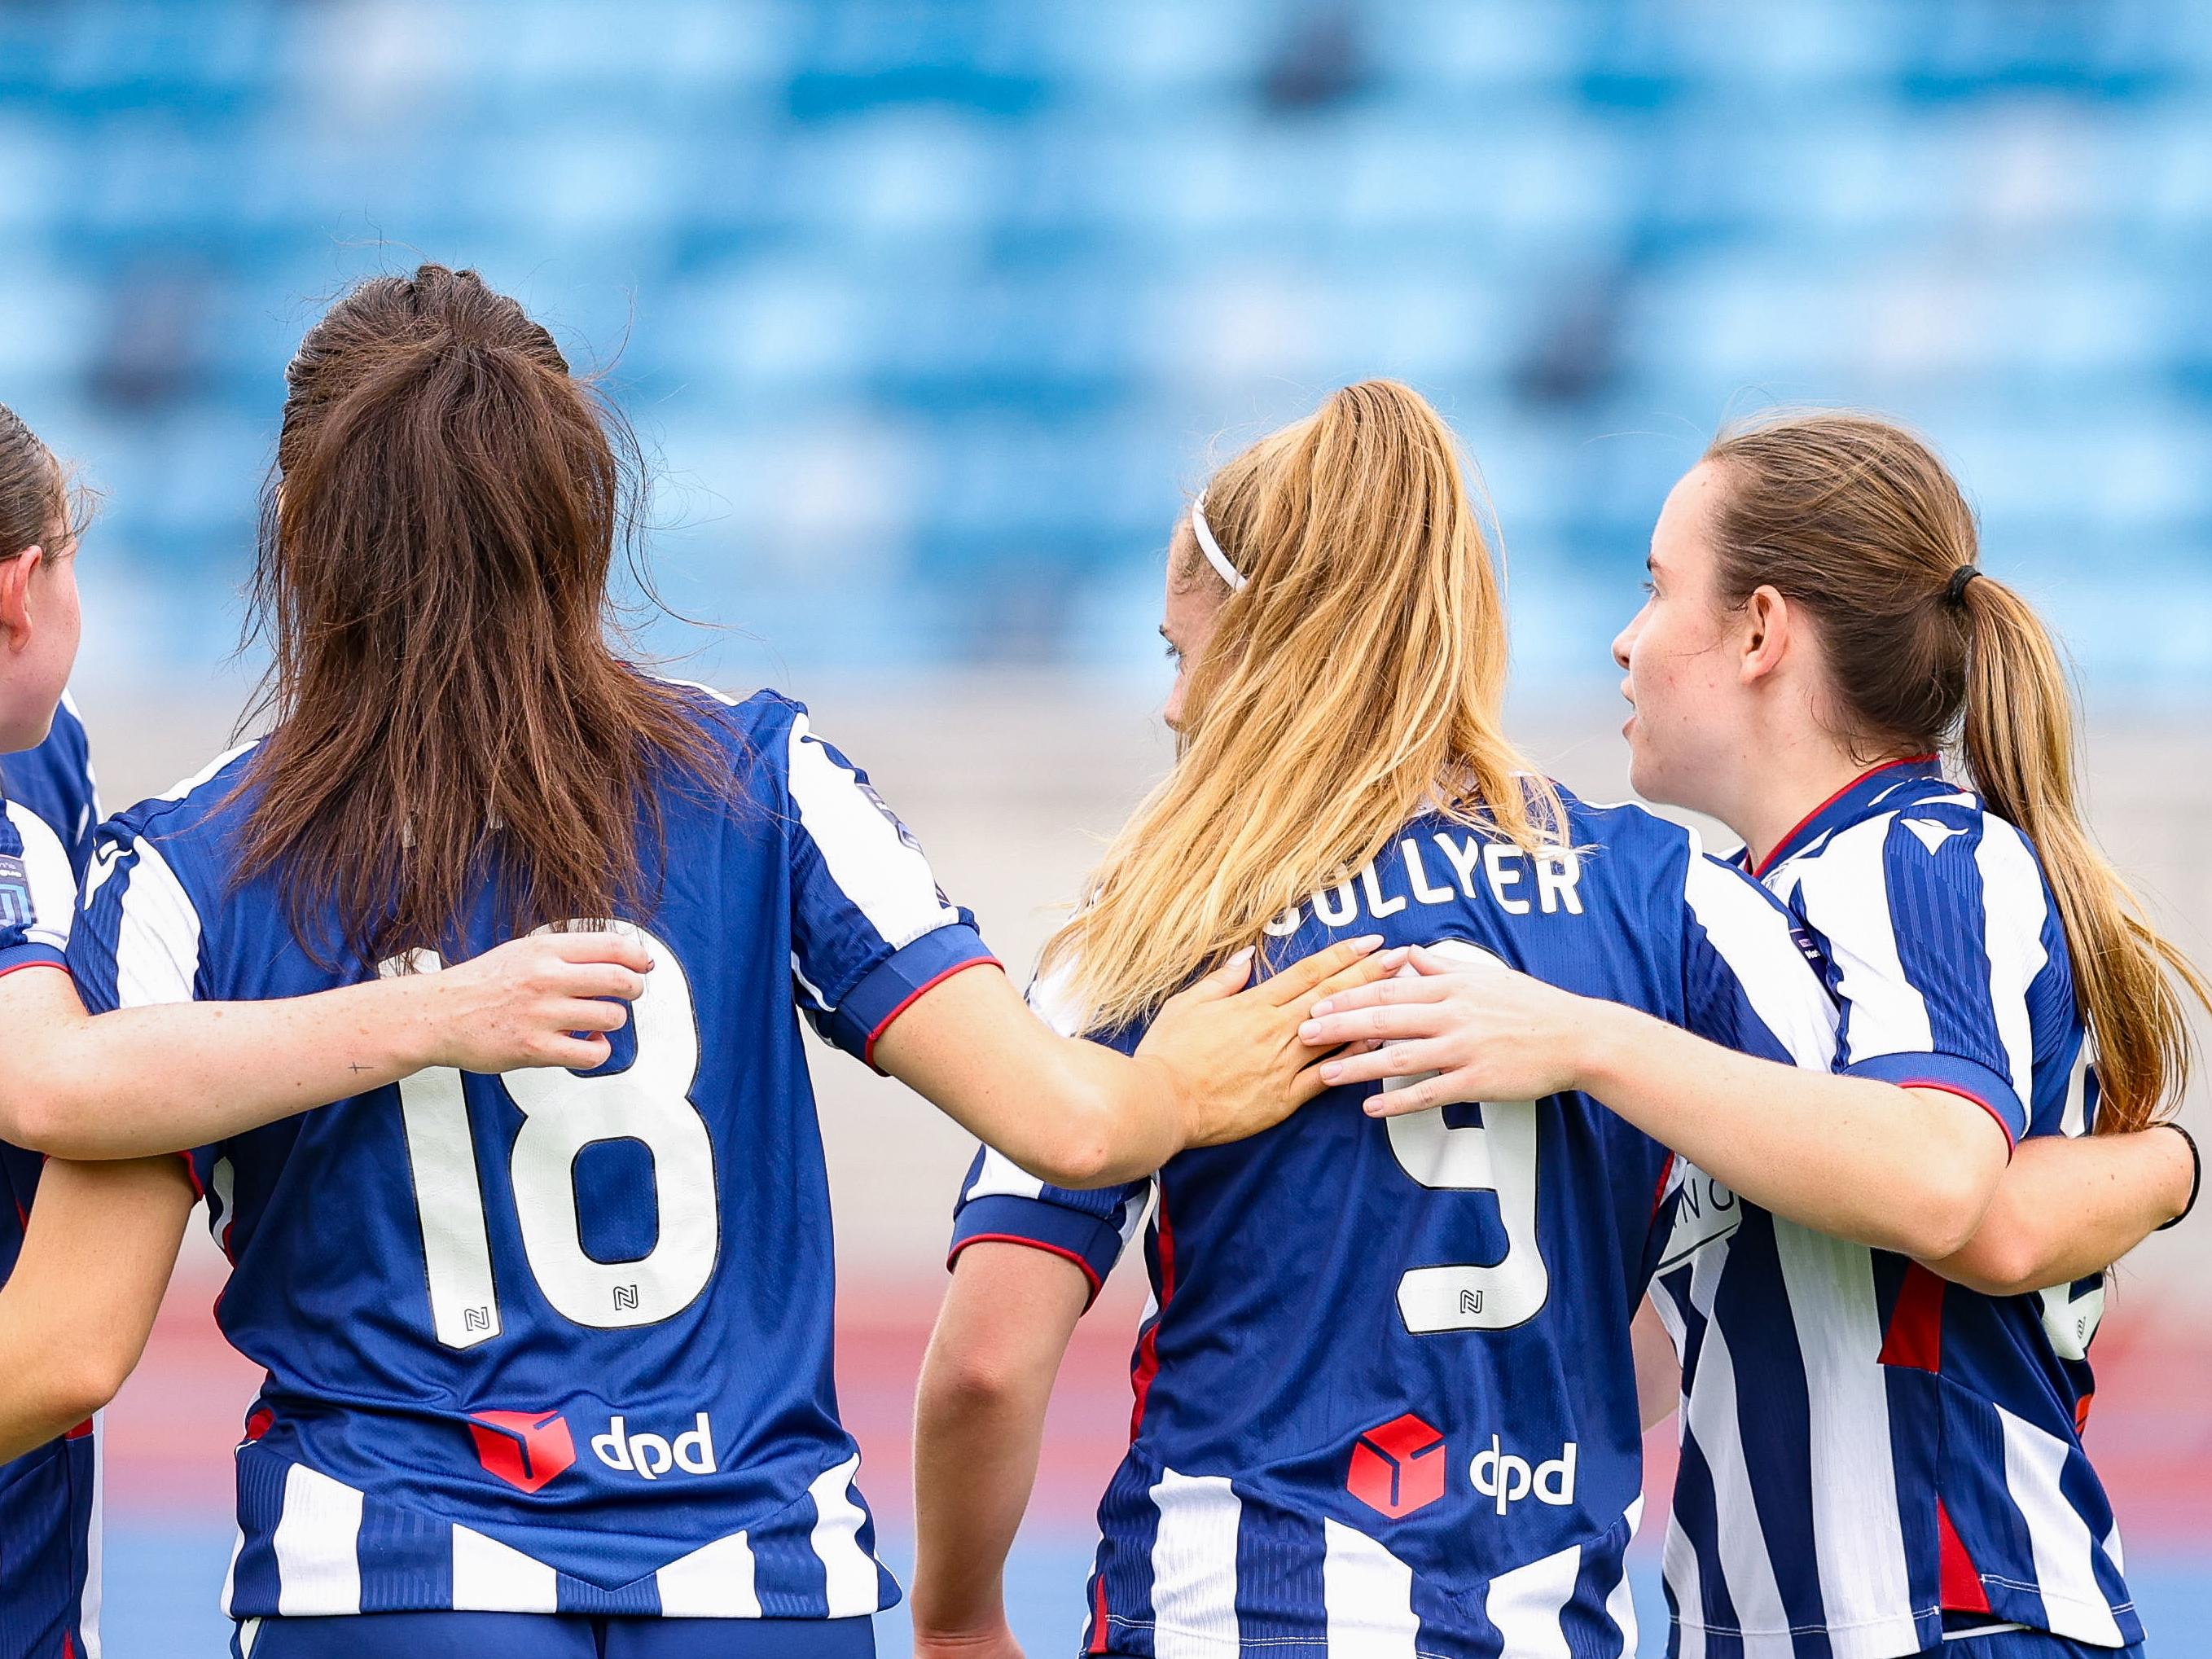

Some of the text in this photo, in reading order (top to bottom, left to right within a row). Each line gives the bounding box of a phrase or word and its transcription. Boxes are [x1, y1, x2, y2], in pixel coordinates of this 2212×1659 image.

[378, 919, 721, 1350] 18
[1382, 938, 1549, 1336] 9
[590, 1412, 717, 1480] dpd
[1469, 1433, 1577, 1516] dpd
